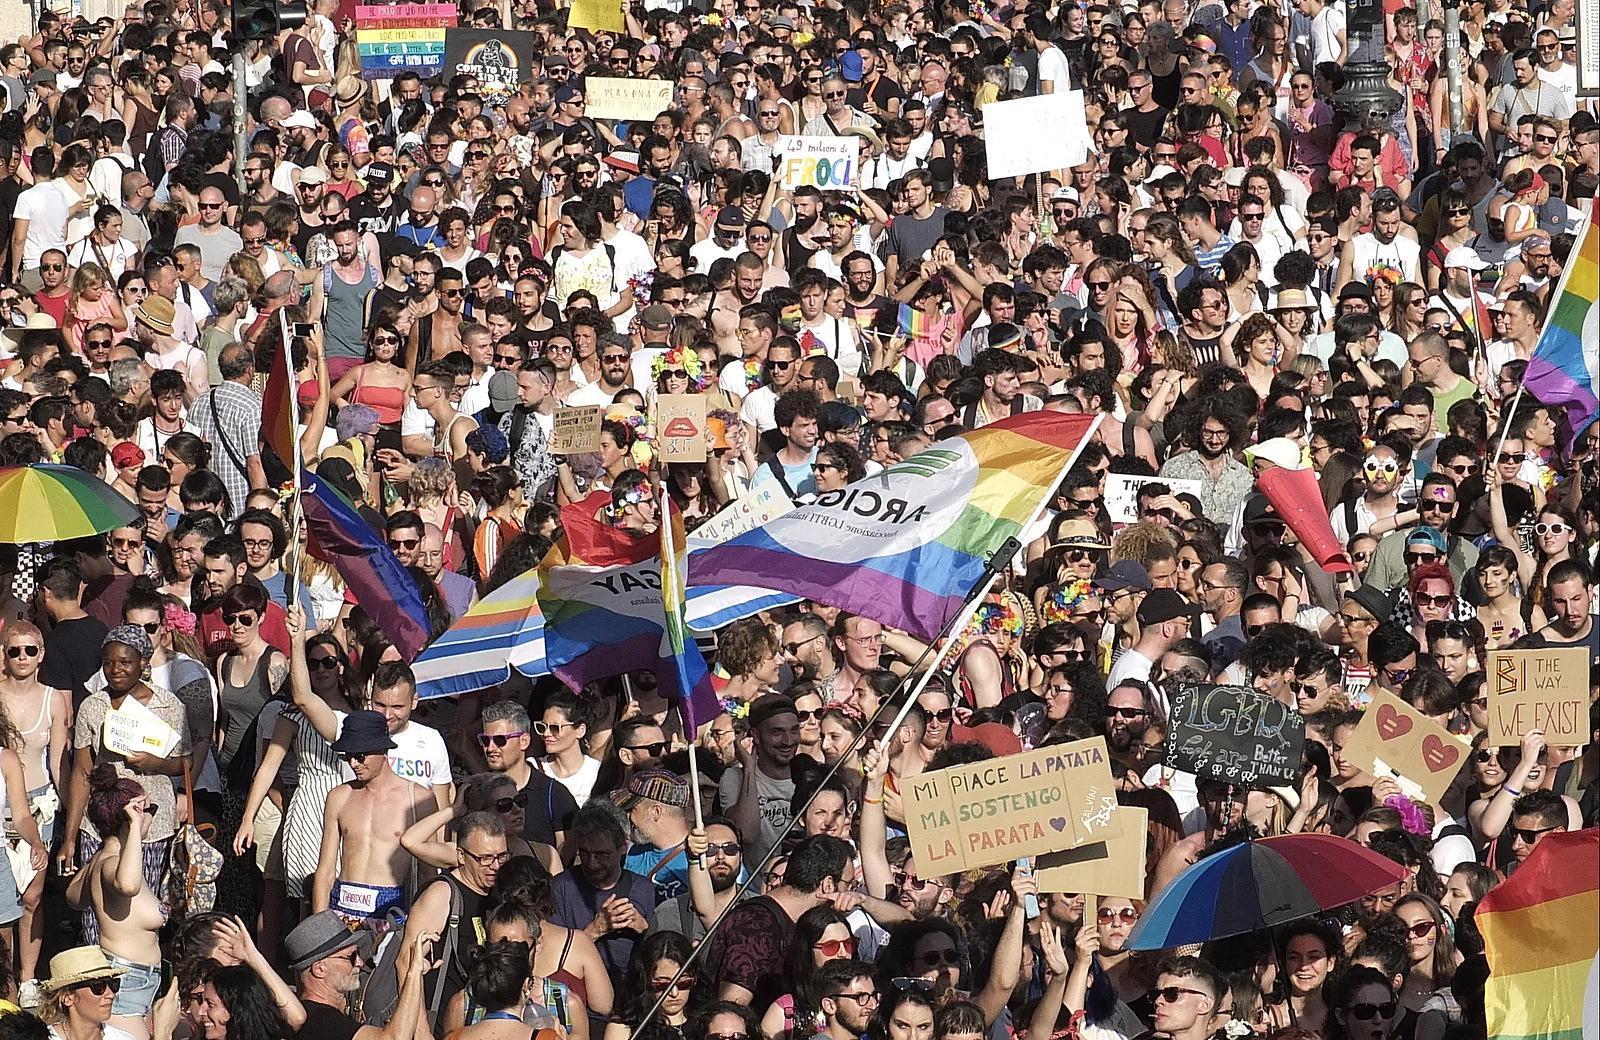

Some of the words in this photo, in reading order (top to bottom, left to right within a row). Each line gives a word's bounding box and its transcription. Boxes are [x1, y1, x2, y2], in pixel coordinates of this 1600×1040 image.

[455, 63, 483, 73] COME
[485, 66, 498, 74] TO
[500, 66, 519, 77] THE
[477, 73, 501, 82] SIDE
[786, 138, 803, 153] 49
[807, 140, 837, 153] milioni
[840, 143, 848, 153] di
[1496, 655, 1527, 695] BI
[1535, 658, 1561, 673] THE
[1497, 703, 1526, 737] WE
[1534, 701, 1582, 735] EXIST
[1019, 760, 1042, 780] LA
[1045, 747, 1104, 773] PATATA
[1254, 743, 1289, 765] Better
[1250, 760, 1282, 777] THAN
[920, 810, 951, 830] MA
[959, 786, 1062, 823] SOSTENGO
[927, 839, 957, 862] LA
[968, 821, 1046, 852] PARATA
